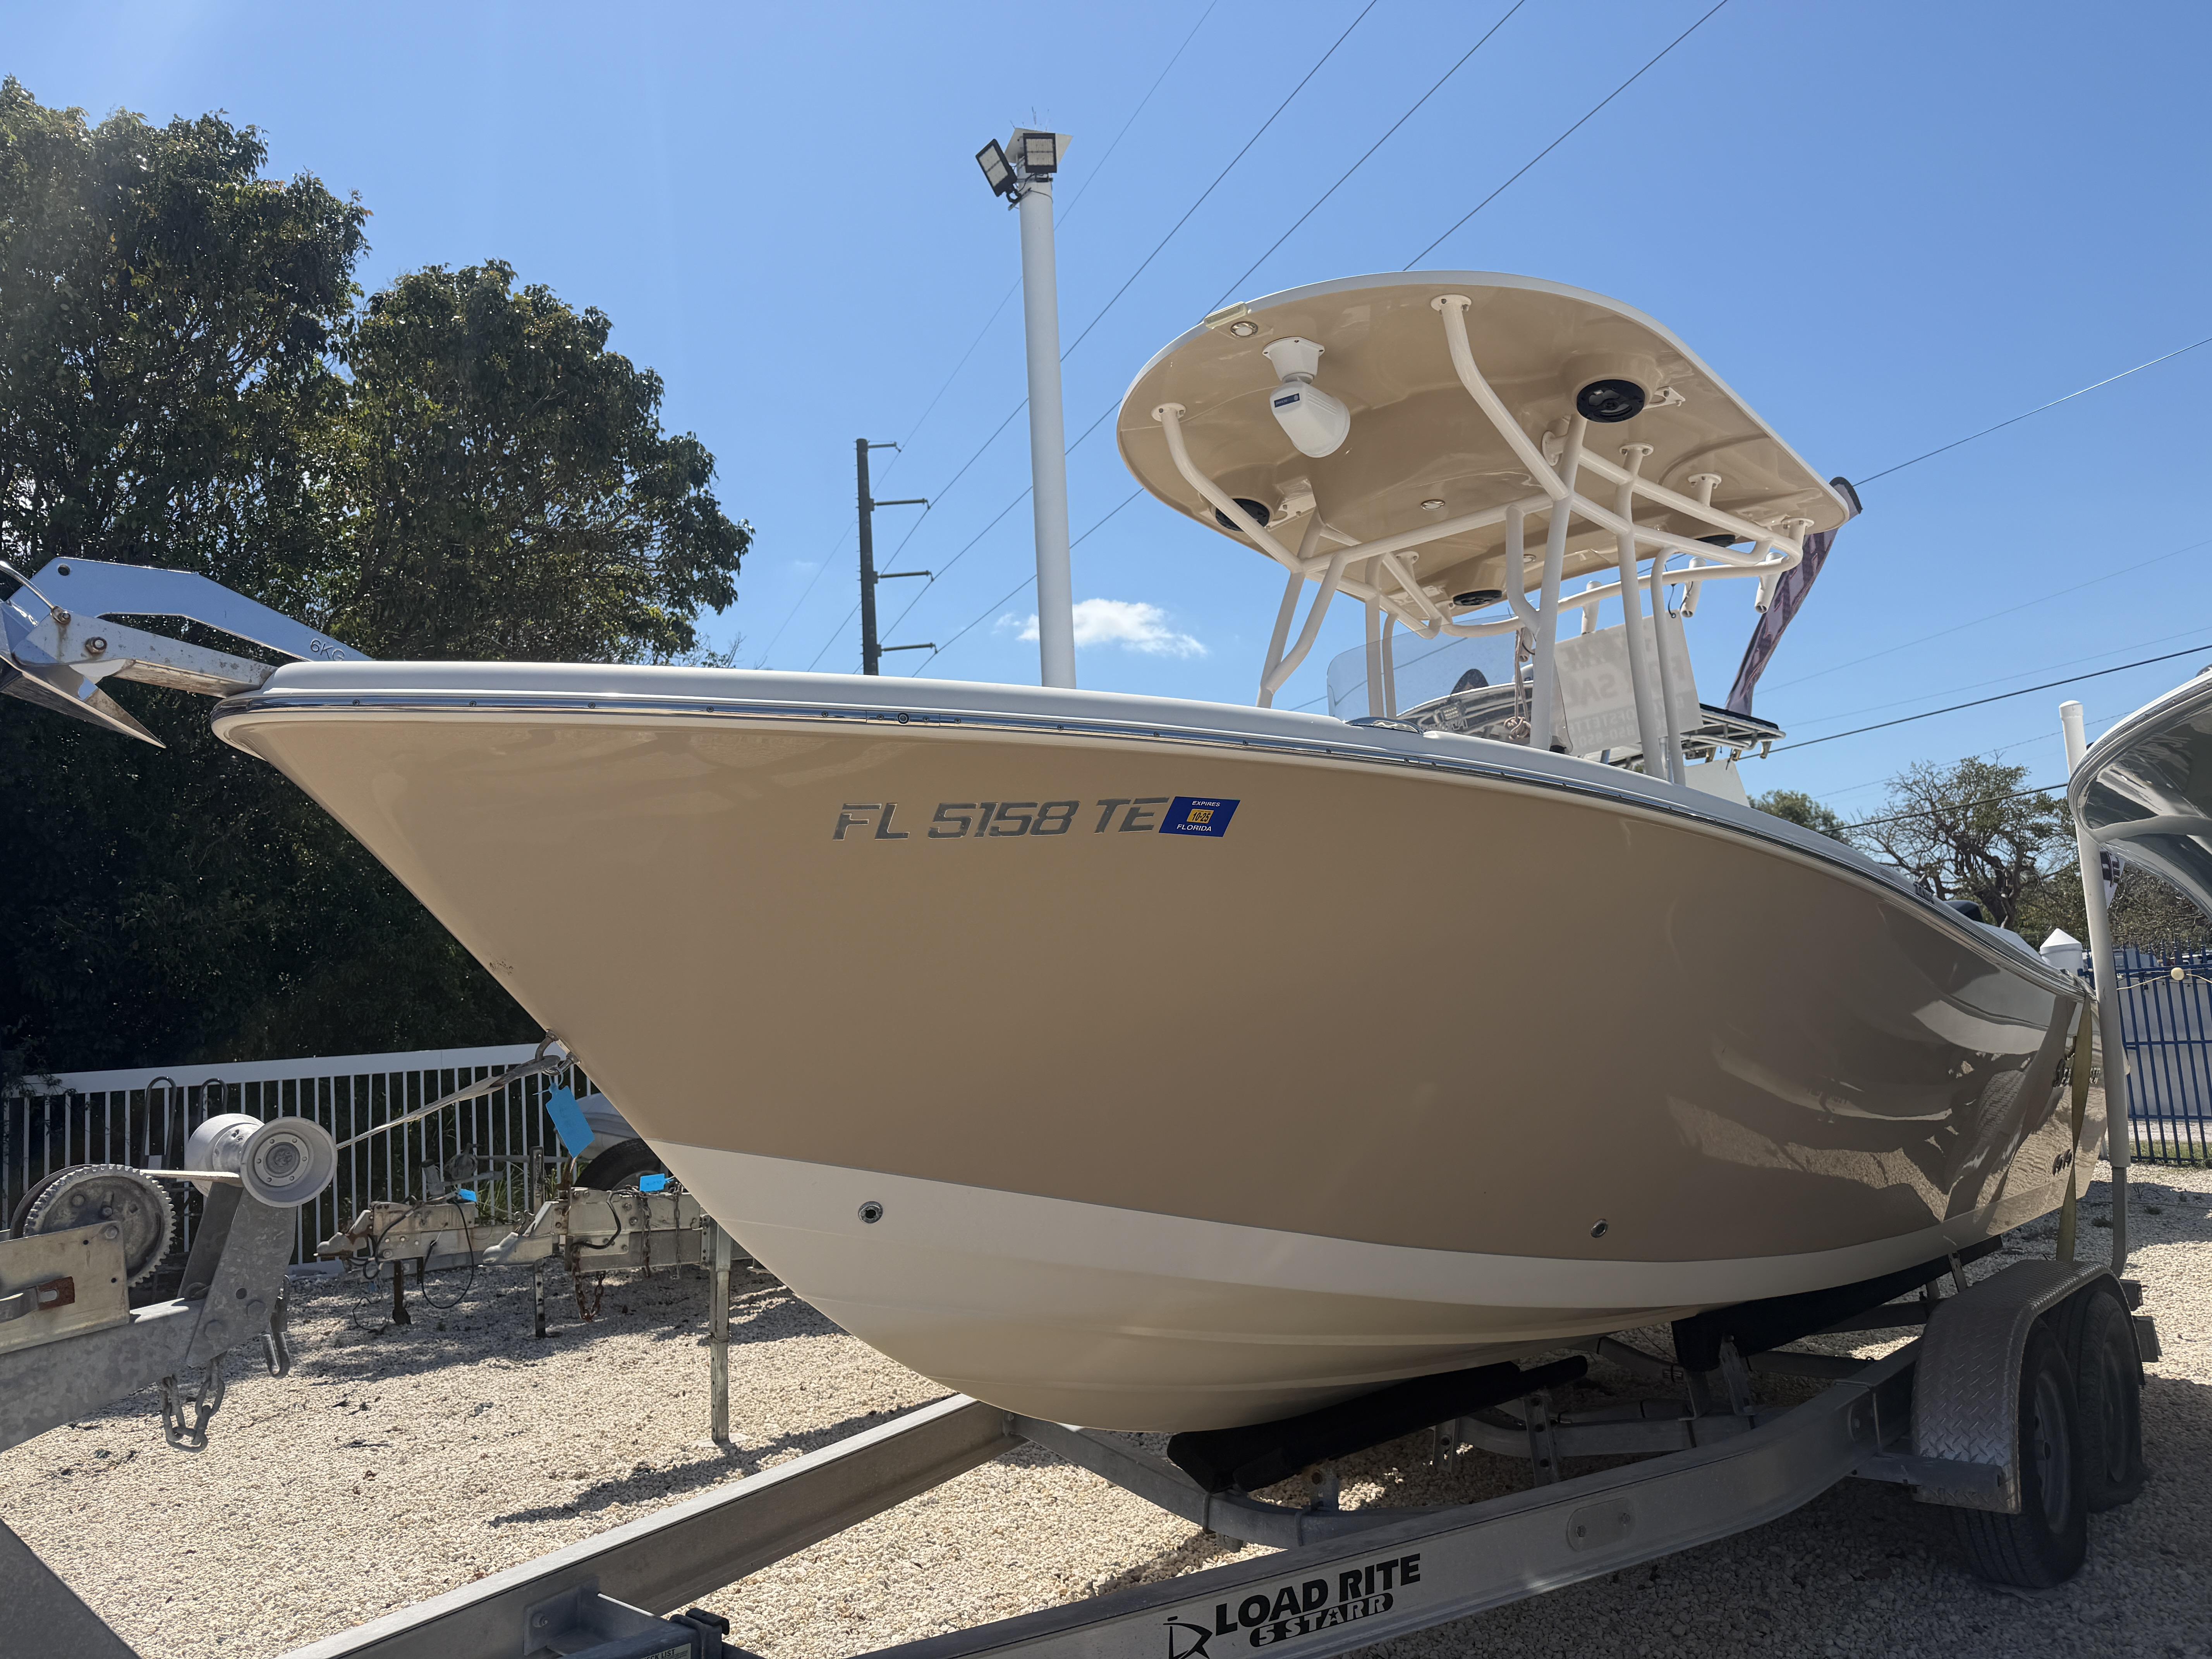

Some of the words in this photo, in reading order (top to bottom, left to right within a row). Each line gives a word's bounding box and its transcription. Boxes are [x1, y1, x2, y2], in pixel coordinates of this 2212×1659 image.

[310, 639, 345, 661] 6KG
[833, 802, 910, 841] FL
[928, 800, 1080, 839] 5158
[1094, 797, 1170, 834] TE
[1176, 824, 1212, 832] FLORIDA
[1192, 812, 1211, 822] 10-25
[1216, 1578, 1328, 1636] LOAD
[1339, 1553, 1420, 1602] RITE
[1259, 1625, 1276, 1646] 5
[1285, 1594, 1386, 1638] STARR
[661, 1649, 676, 1658] LIST
